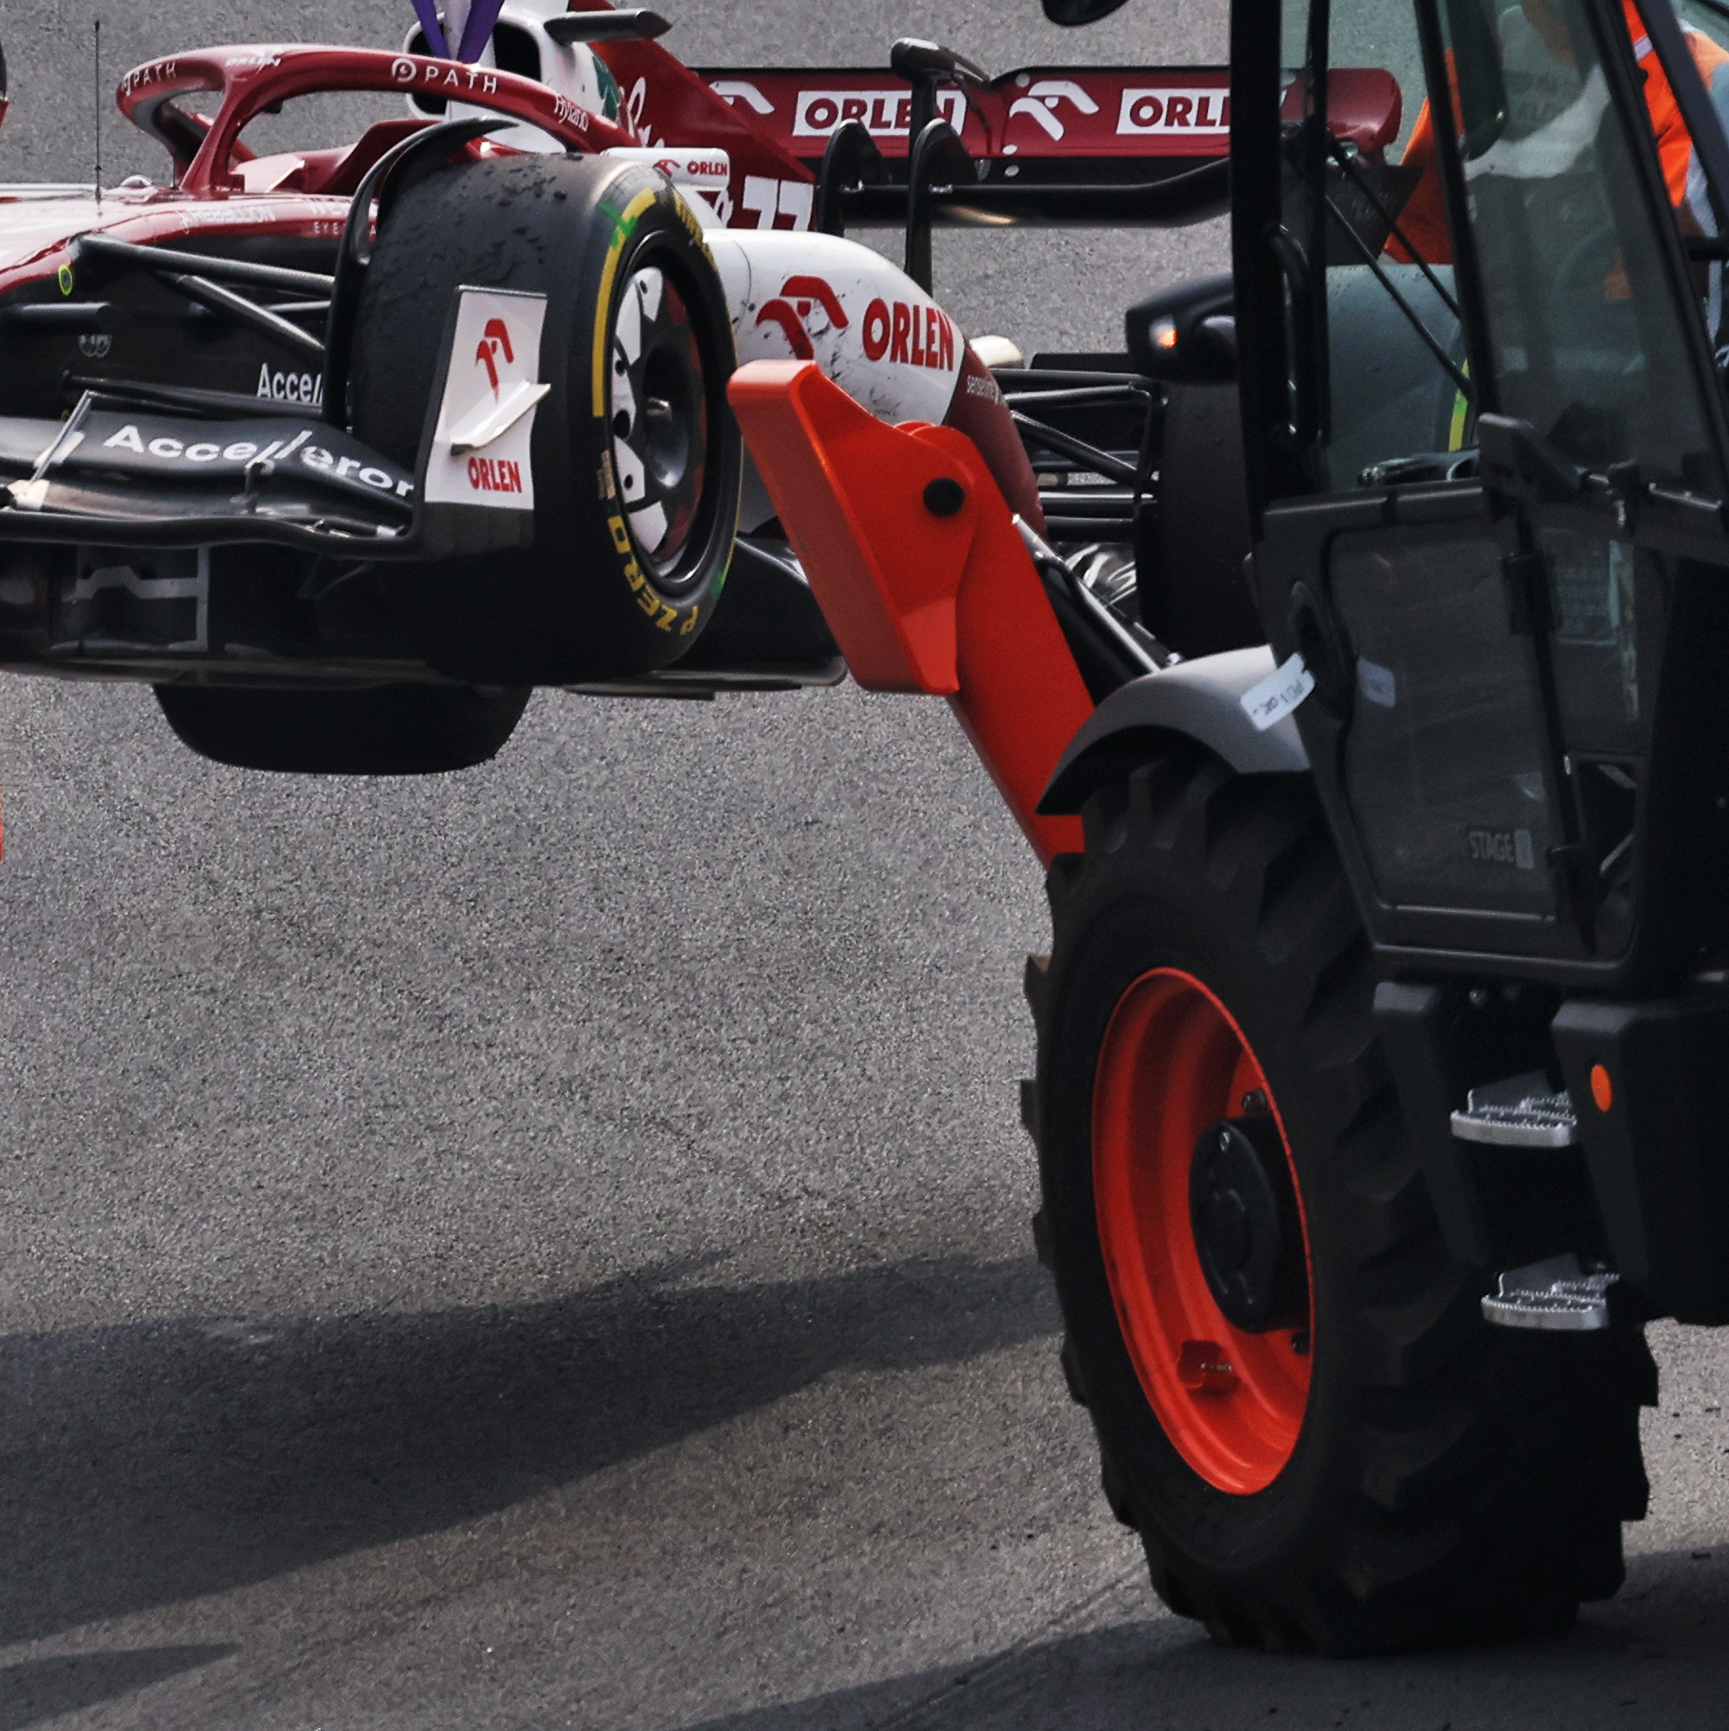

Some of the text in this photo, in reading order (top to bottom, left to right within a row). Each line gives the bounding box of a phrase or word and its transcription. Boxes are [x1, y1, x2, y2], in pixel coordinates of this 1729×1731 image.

[424, 65, 498, 95] PATH
[687, 160, 728, 176] ORLEN
[742, 174, 814, 231] 77
[862, 297, 954, 372] ORLEN
[467, 456, 522, 494] ORLEN
